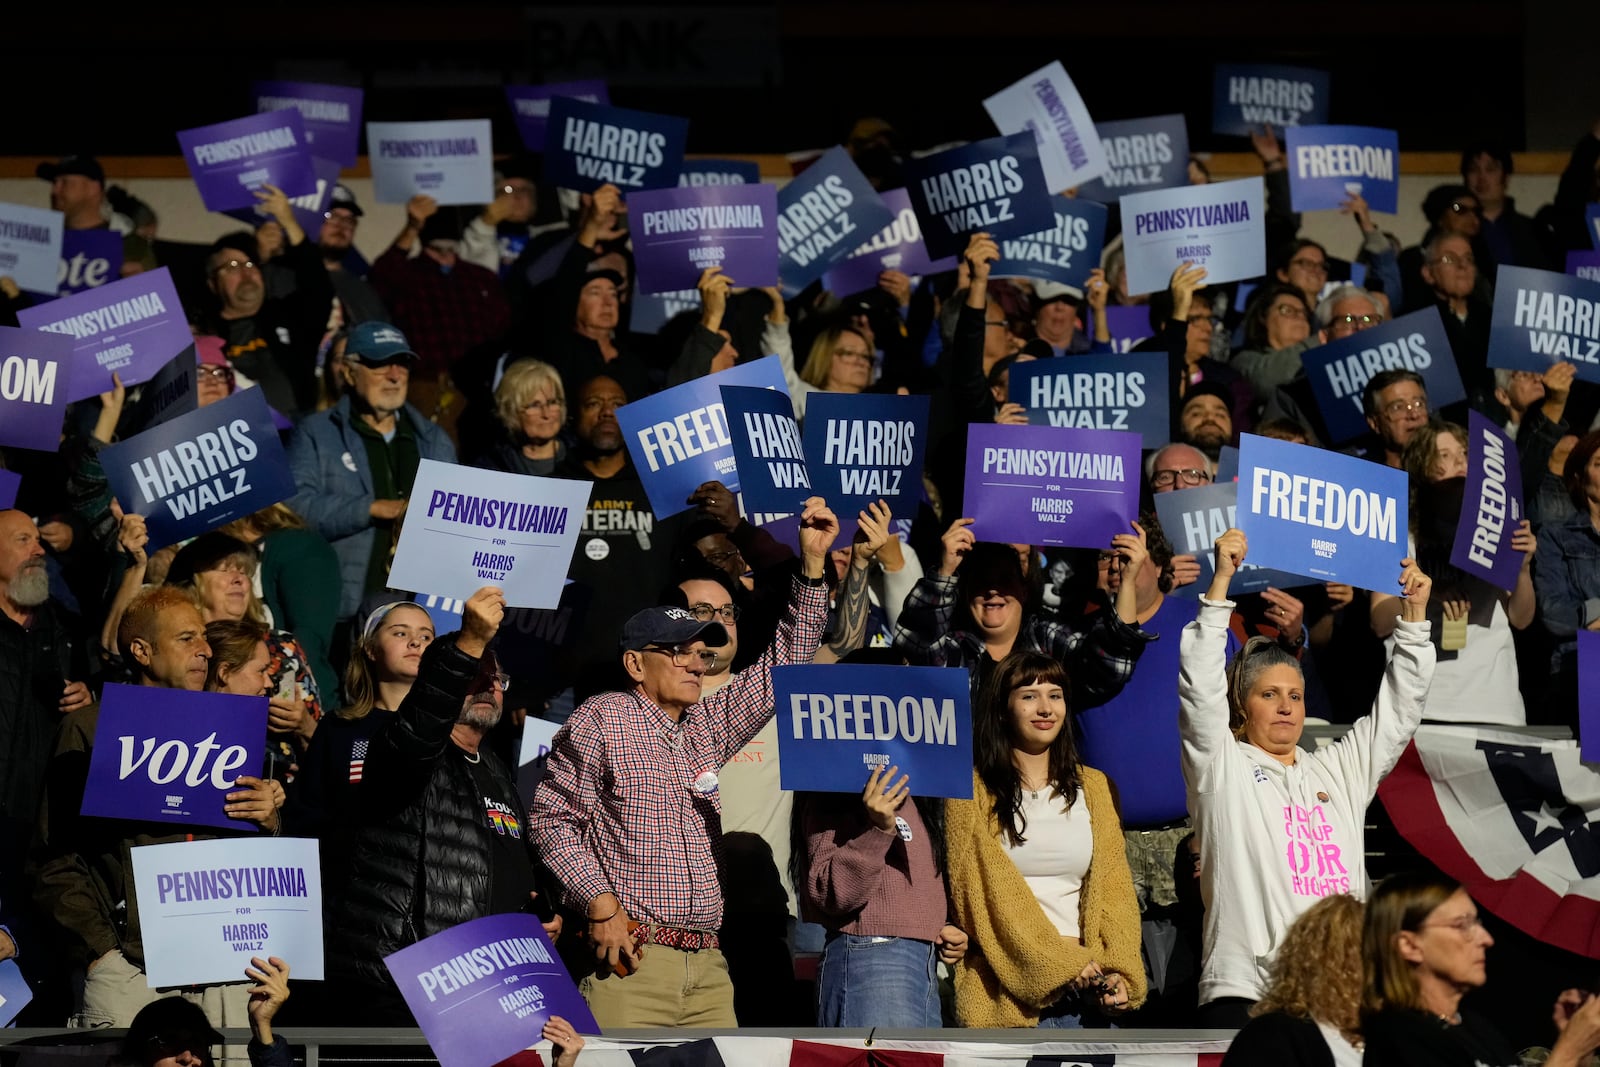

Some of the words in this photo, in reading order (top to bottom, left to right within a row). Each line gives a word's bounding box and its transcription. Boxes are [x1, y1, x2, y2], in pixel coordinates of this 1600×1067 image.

[1229, 76, 1314, 112] HARRIS
[1033, 77, 1089, 171] PENNSYLVANIA
[1241, 106, 1301, 127] WALZ
[193, 126, 297, 166] PENNSYLVANIA
[380, 137, 478, 158] PENNSYLVANIA
[563, 116, 666, 168] HARRIS
[1102, 132, 1173, 168] ARRIS
[575, 155, 647, 187] WALZ
[1101, 165, 1164, 188] WALZ
[1296, 143, 1393, 182] FREEDOM
[677, 172, 746, 188] ARRIS
[921, 155, 1024, 215] HARRIS
[642, 204, 764, 236] PENNSYLVANIA
[944, 198, 1015, 234] WALZ
[1136, 200, 1250, 236] PENNSYLVANIA
[688, 246, 726, 261] HARRIS
[789, 212, 857, 267] WALZ
[1176, 244, 1211, 259] HARRIS
[1003, 240, 1074, 269] WALZ
[95, 343, 134, 366] HARRIS
[1529, 329, 1600, 364] WALZ
[1325, 333, 1432, 399] HARRIS
[1030, 371, 1146, 410] HARRIS
[1047, 409, 1129, 430] WALZ
[824, 418, 915, 467] HARRIS
[130, 418, 258, 504] HARRIS
[982, 447, 1125, 482] PENNSYLVANIA
[165, 468, 252, 521] WALZ
[840, 468, 902, 496] WALZ
[1046, 484, 1061, 492] FOR
[427, 489, 569, 535] PENNSYLVANIA
[593, 499, 635, 510] ARMY
[1031, 496, 1073, 514] HARRIS
[1251, 466, 1397, 544] FREEDOM
[1468, 428, 1505, 570] FREEDOM
[582, 509, 653, 534] TERAN
[1037, 513, 1066, 524] WALZ
[491, 537, 507, 546] FOR
[1311, 538, 1337, 555] HARRIS
[1314, 549, 1333, 560] WALZ
[472, 551, 515, 572] HARRIS
[477, 569, 506, 581] WALZ
[790, 693, 957, 746] FREEDOM
[118, 731, 248, 791] vote
[733, 752, 764, 762] ENT
[863, 753, 890, 765] HARRIS
[157, 867, 308, 904] PENNSYLVANIA
[1291, 875, 1350, 897] RIGHTS
[235, 907, 251, 915] FOR
[222, 923, 269, 942] HARRIS
[232, 941, 263, 952] WALZ
[417, 936, 555, 1003] PENNSYLVANIA
[503, 973, 519, 985] FOR
[498, 984, 545, 1014] HARRIS
[514, 1000, 547, 1019] WALZ
